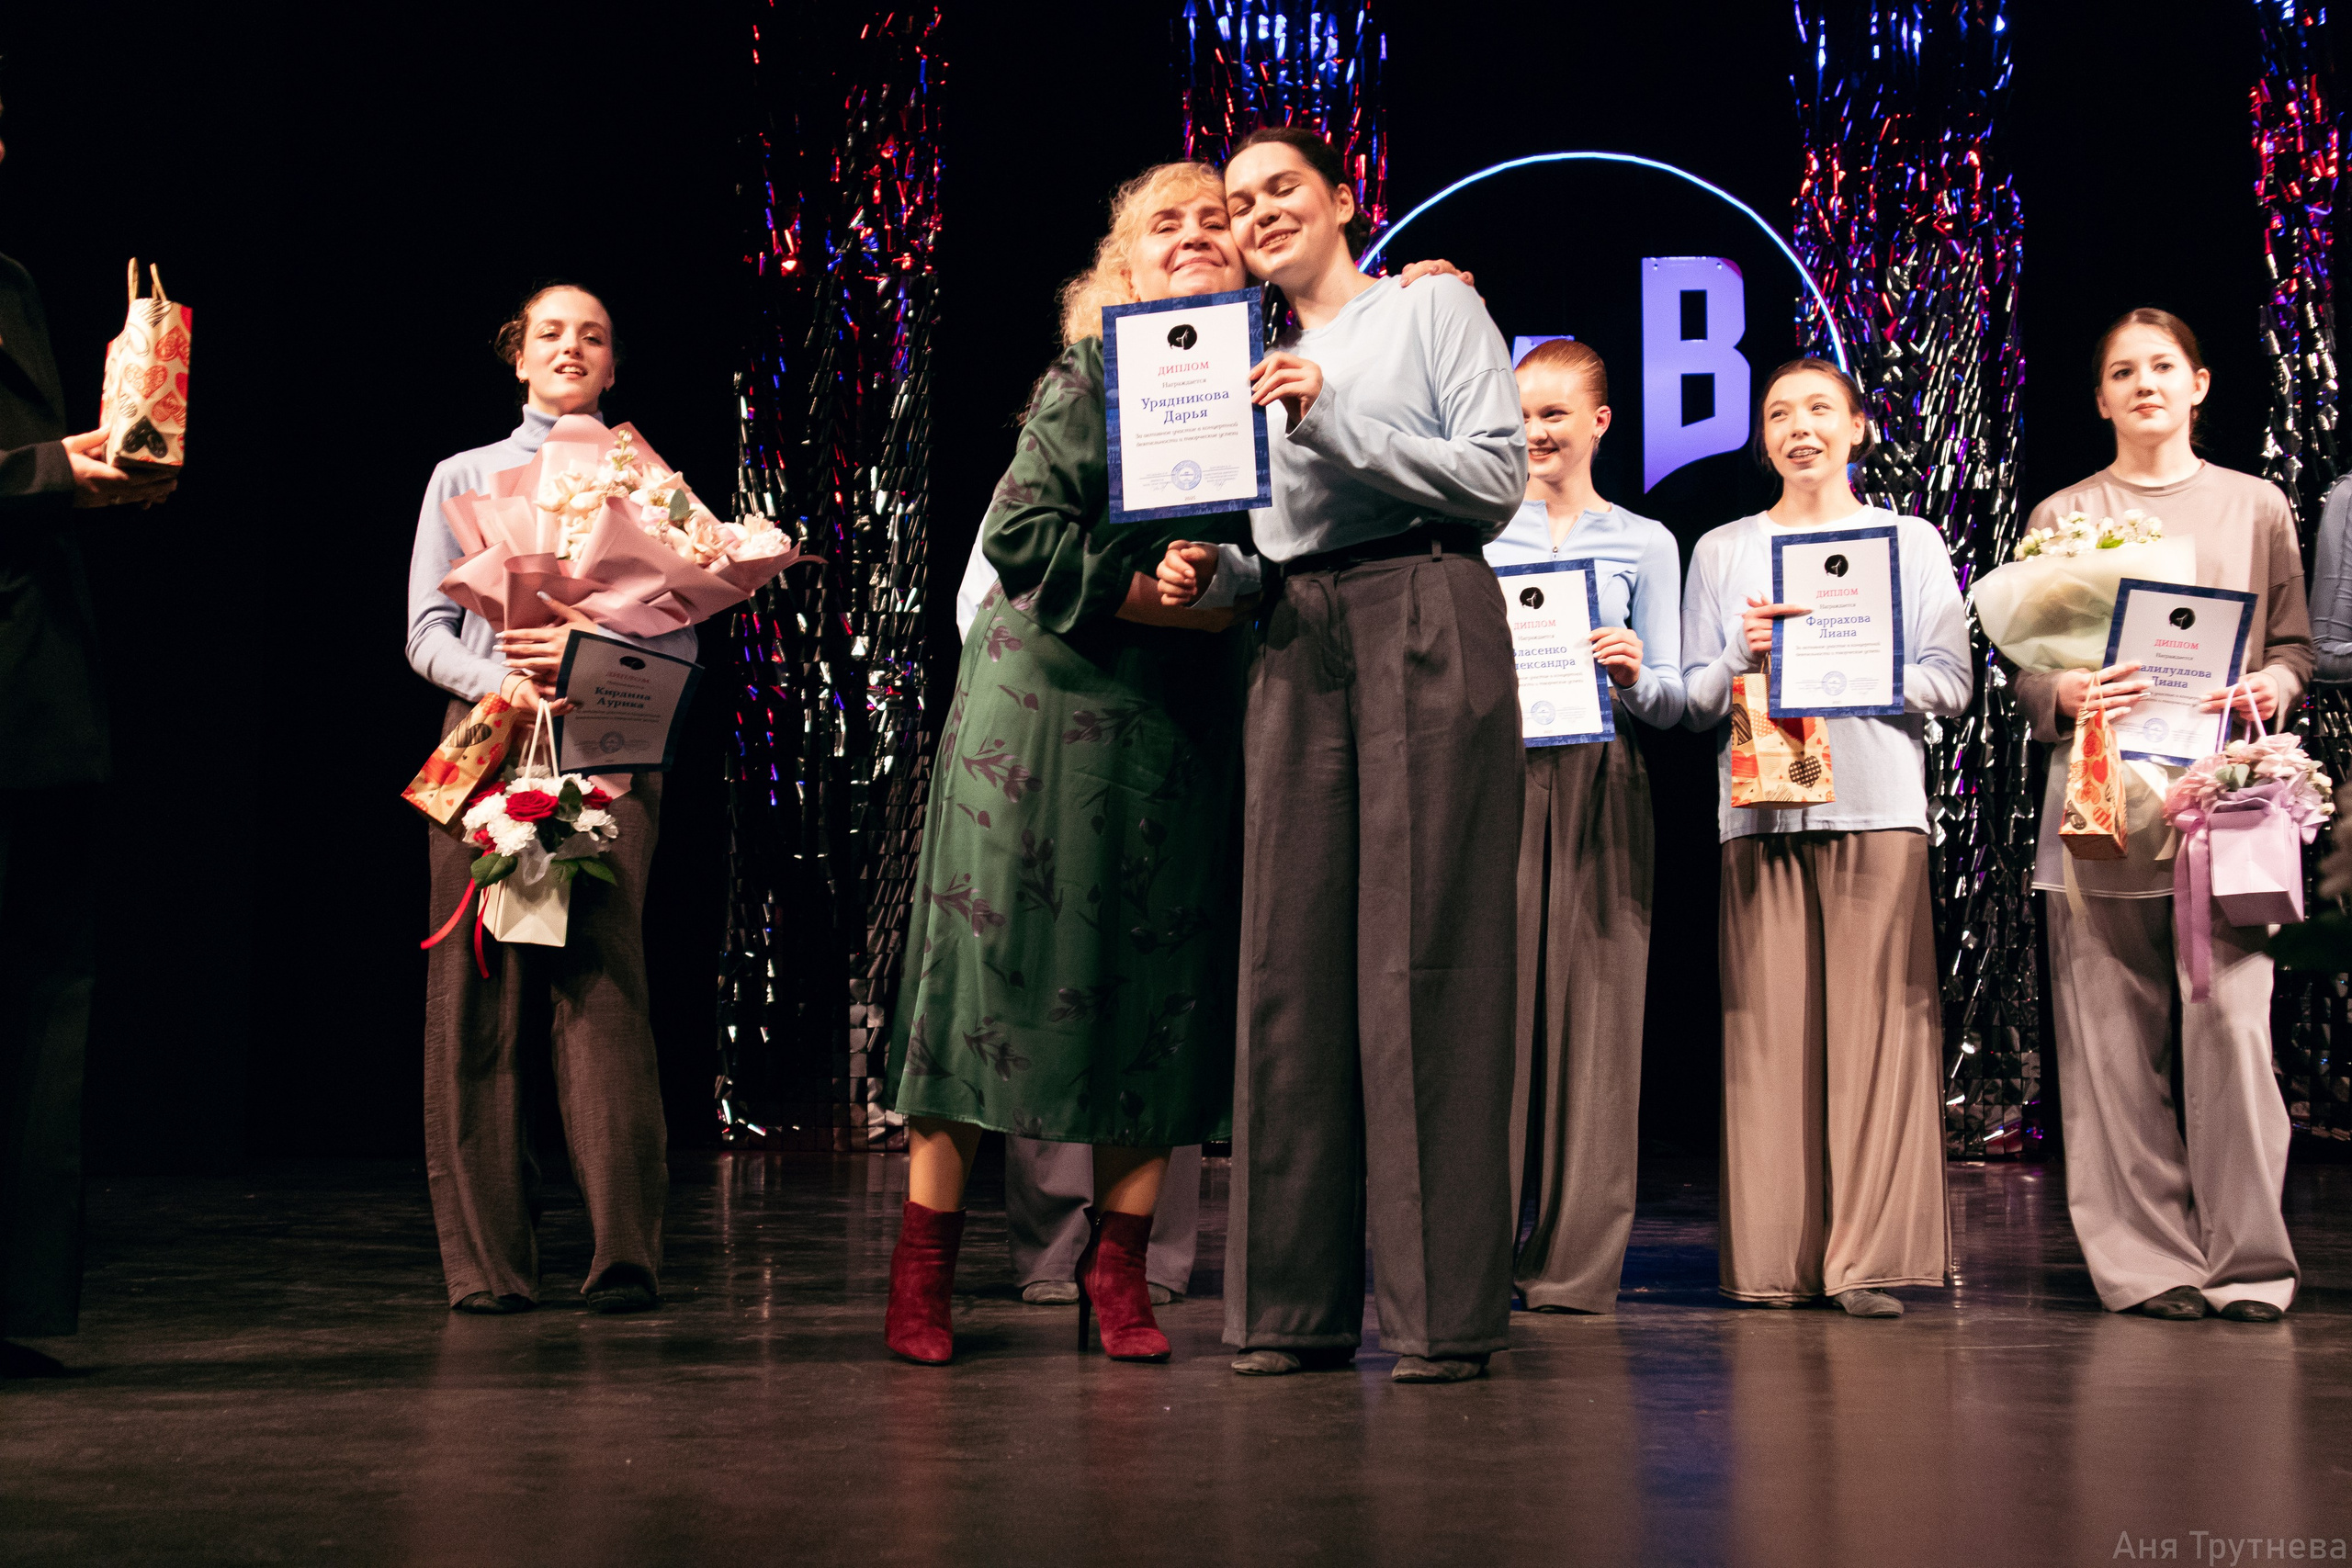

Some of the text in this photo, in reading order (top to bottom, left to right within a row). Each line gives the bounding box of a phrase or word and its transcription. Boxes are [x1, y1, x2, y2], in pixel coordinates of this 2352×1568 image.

[1158, 361, 1210, 377] ДИПЛОМ
[1162, 378, 1207, 389] Награждается
[1141, 390, 1230, 412] Урядникова
[1163, 409, 1208, 424] Дарья
[1816, 588, 1859, 599] ДИПЛОМ
[1513, 619, 1556, 630] ДИПЛОМ
[1805, 615, 1871, 627] Фаррахова
[1819, 628, 1857, 638] Лиана
[2154, 638, 2199, 649] ДИПЛОМ
[2138, 664, 2212, 678] алилуллова
[594, 686, 650, 700] Кирдина
[597, 697, 644, 708] Аурика
